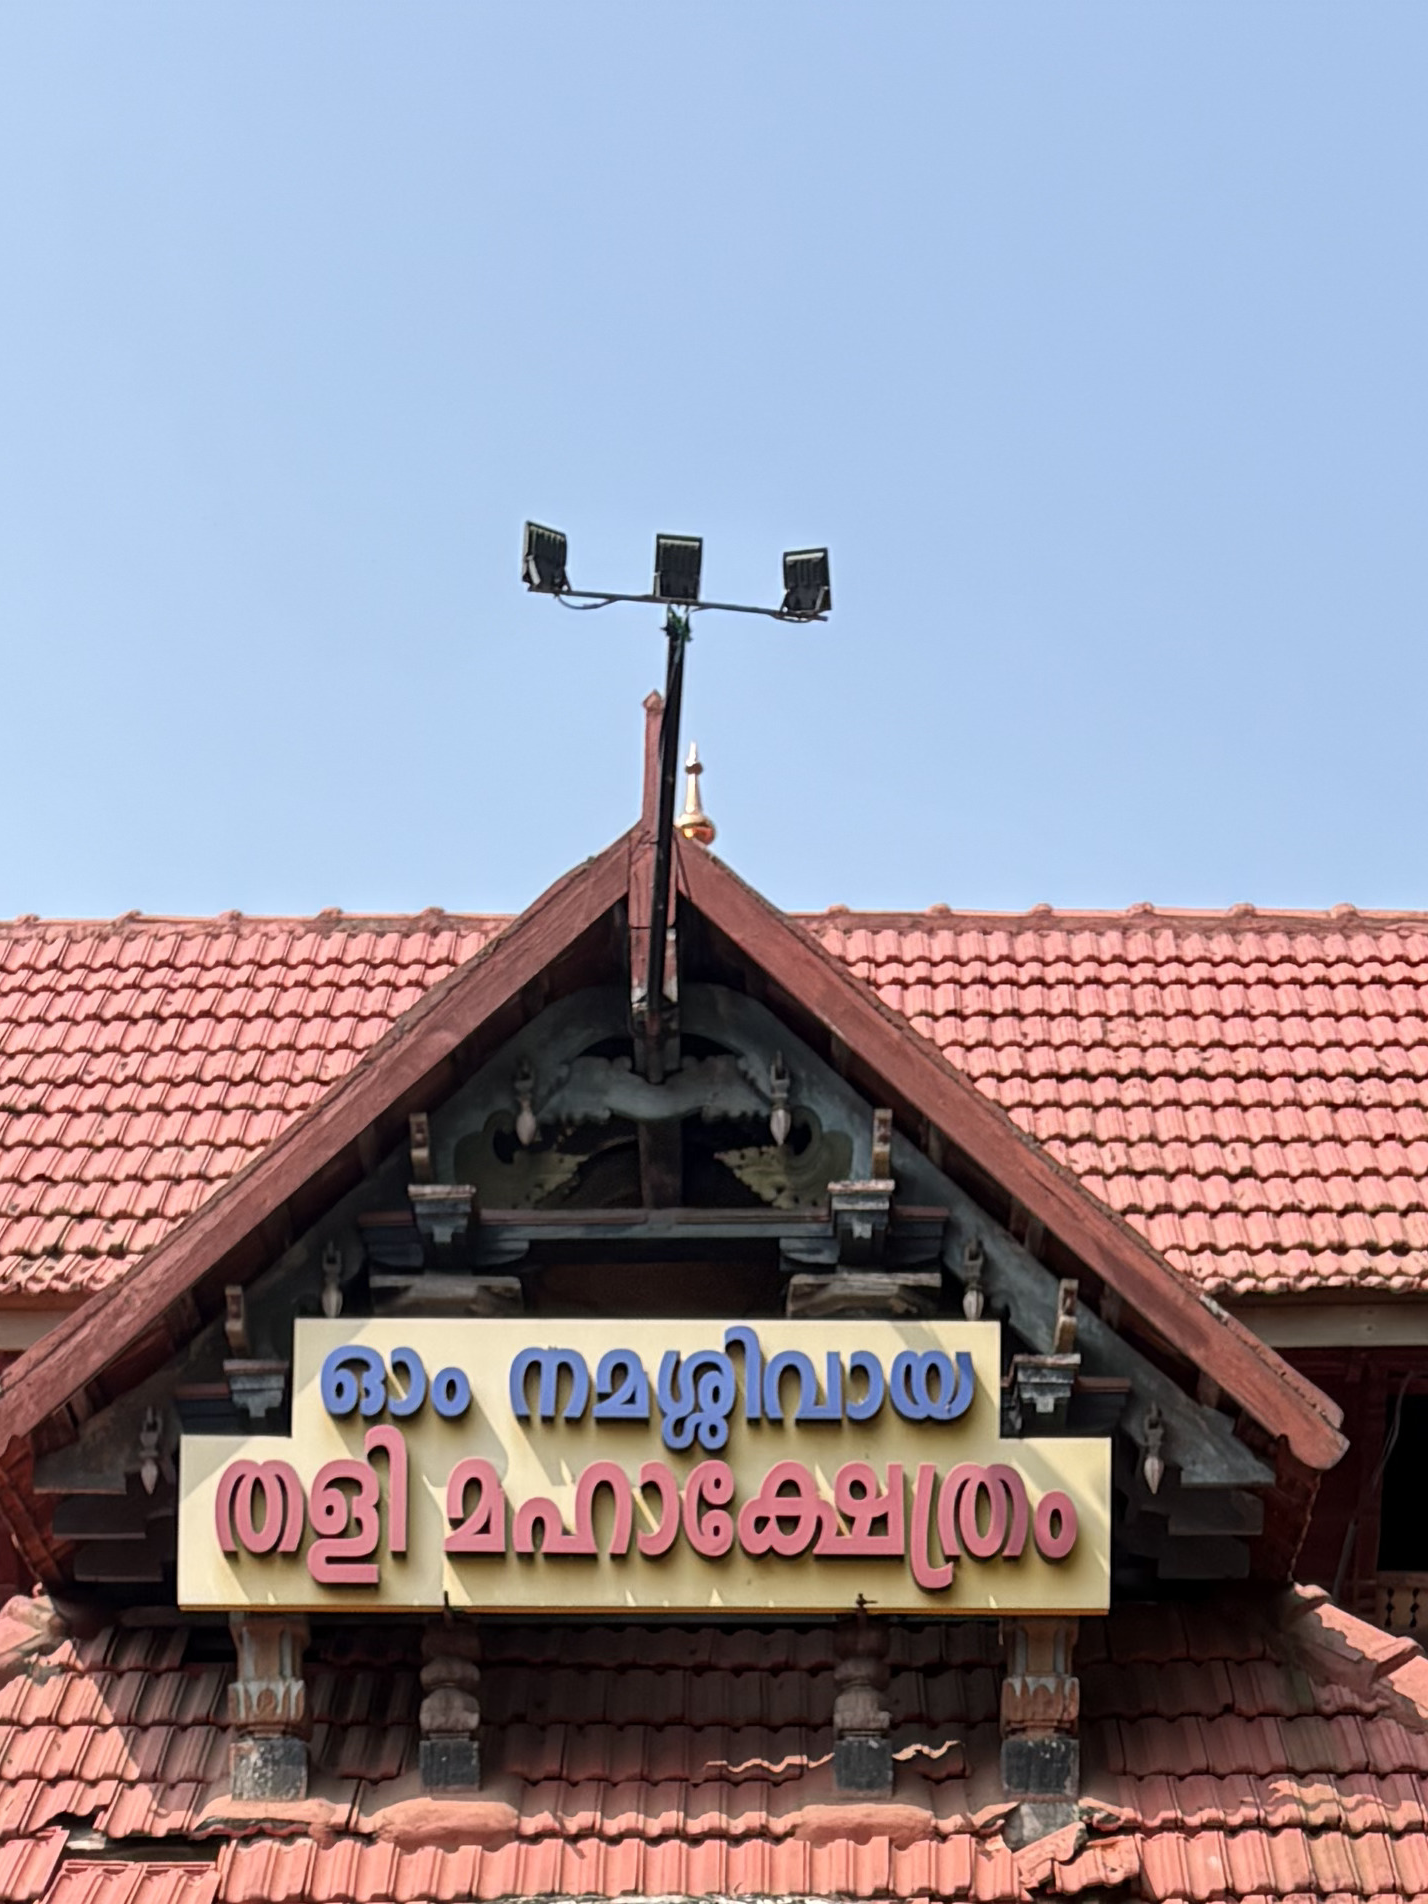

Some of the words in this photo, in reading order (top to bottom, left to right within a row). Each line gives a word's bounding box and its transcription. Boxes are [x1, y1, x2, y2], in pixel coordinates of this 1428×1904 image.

[321, 1344, 472, 1418] ഓം
[509, 1324, 974, 1451] നമശ്ശിവായ
[214, 1424, 410, 1586] തളി
[443, 1458, 1080, 1590] മഹാക്ഷേത്രം
